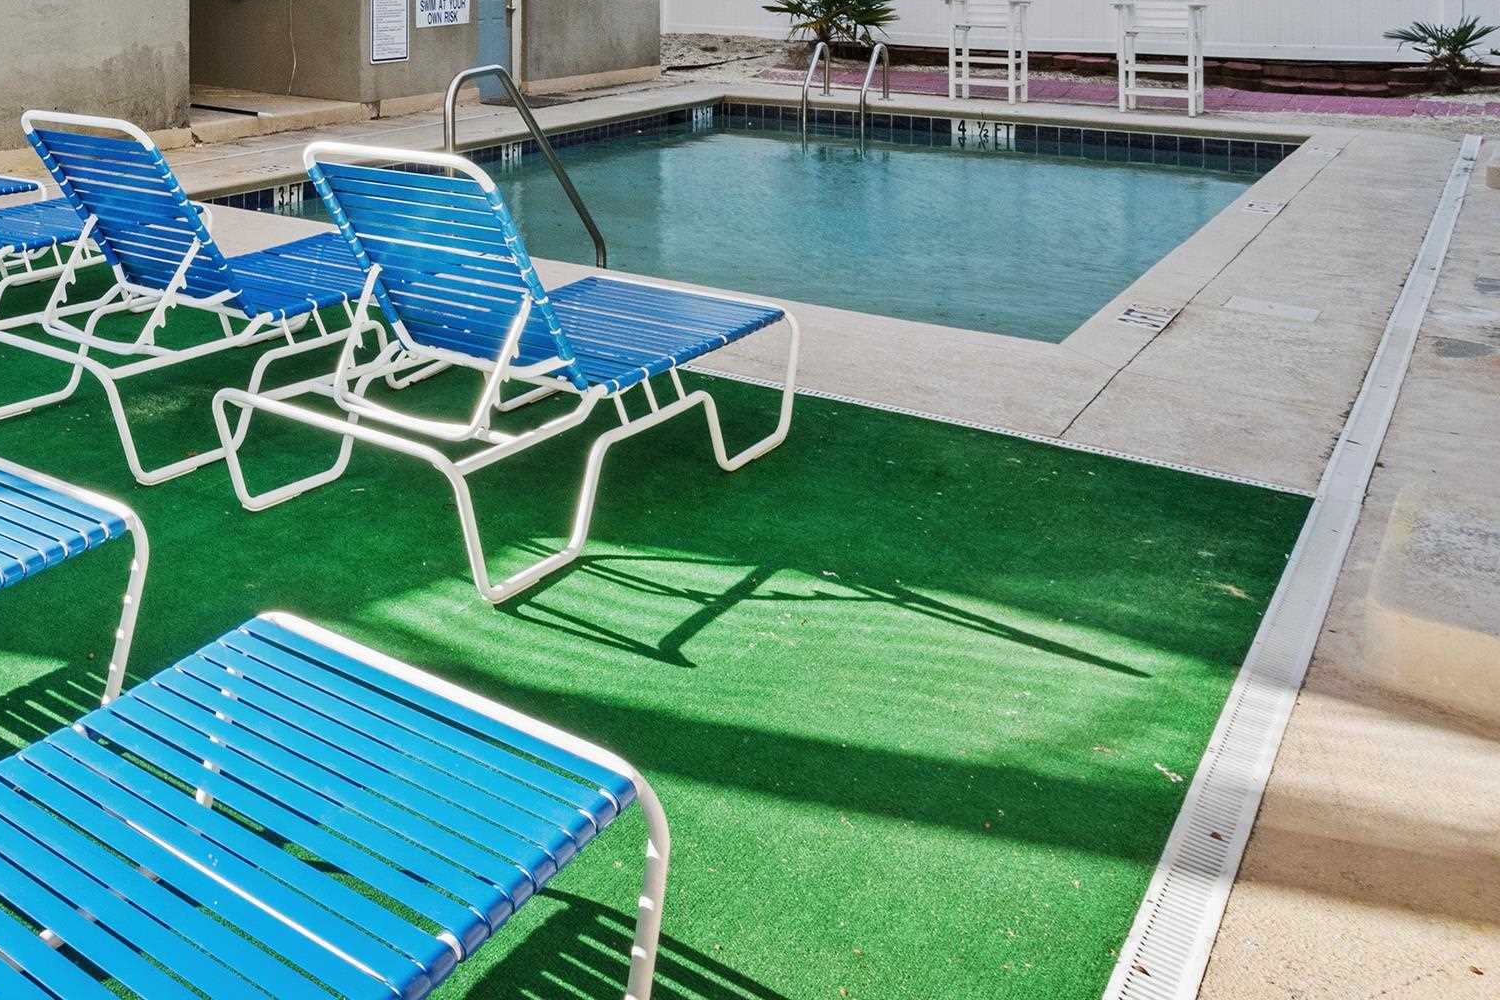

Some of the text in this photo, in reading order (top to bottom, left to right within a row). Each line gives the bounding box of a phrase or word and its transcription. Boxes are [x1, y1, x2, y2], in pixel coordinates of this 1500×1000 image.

[420, 0, 436, 12] SWIM
[427, 12, 442, 25] OWN
[444, 10, 459, 23] RISK
[958, 119, 967, 136] 4
[994, 122, 1014, 141] FT
[289, 182, 302, 204] FT
